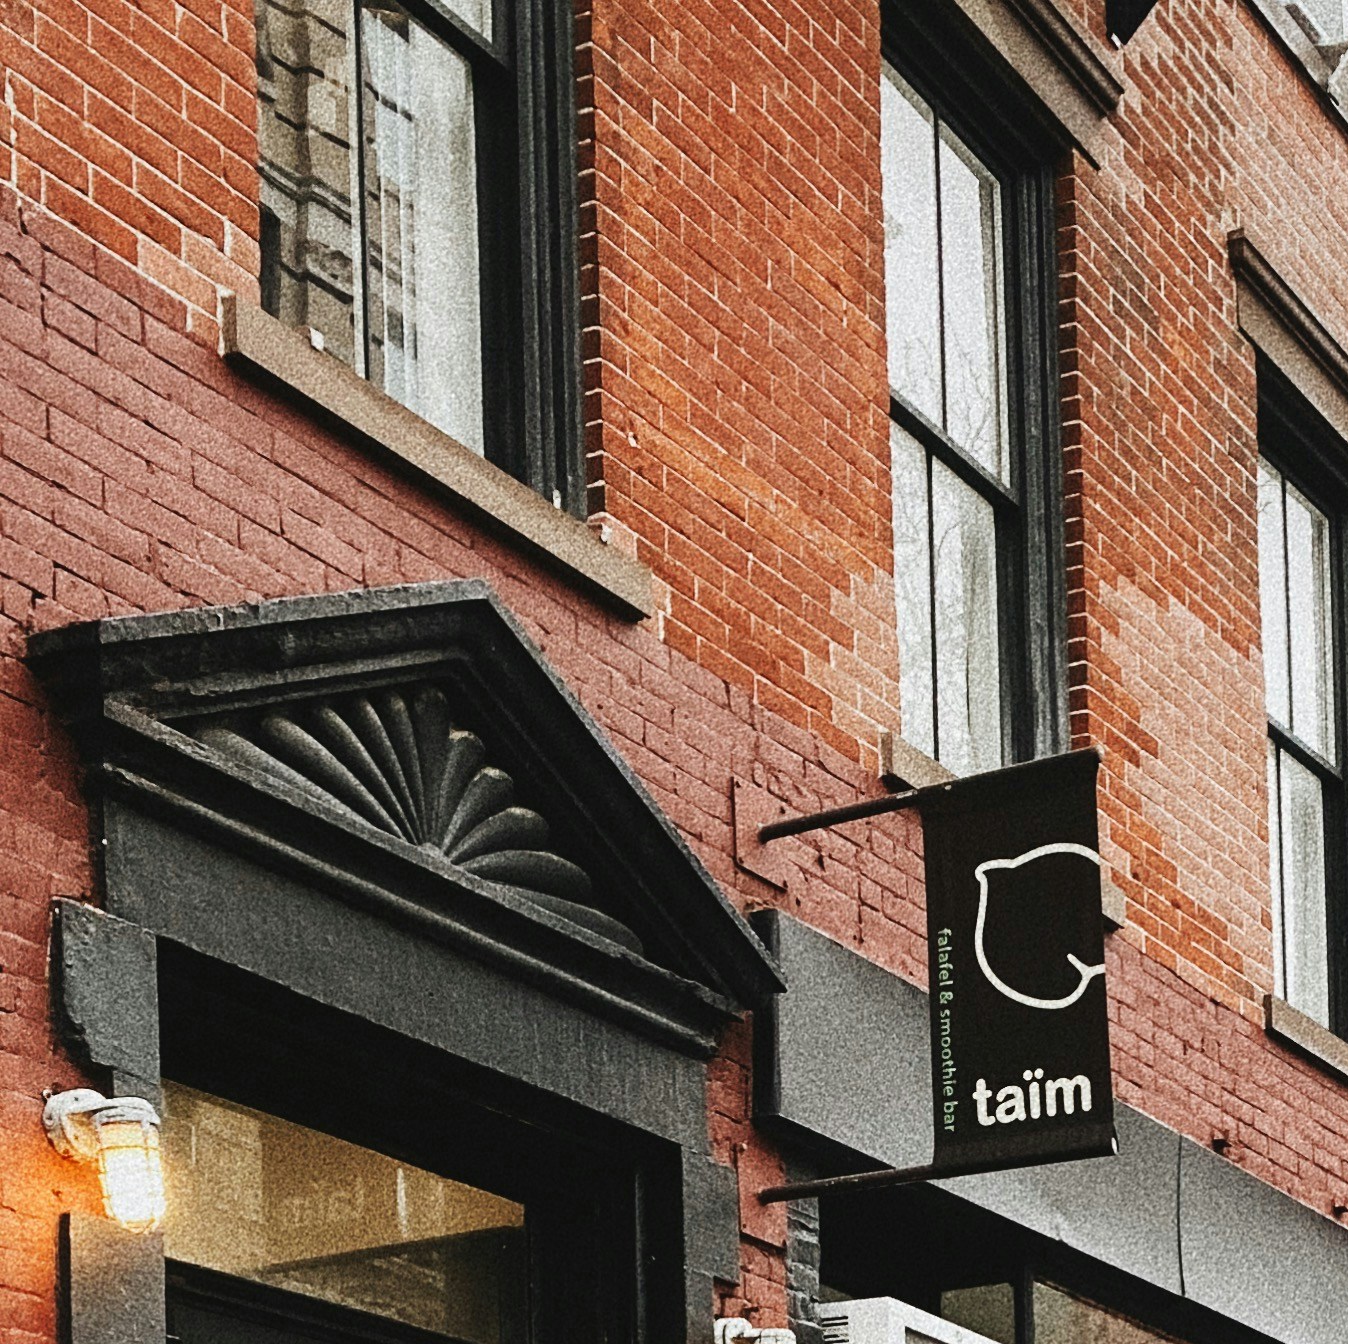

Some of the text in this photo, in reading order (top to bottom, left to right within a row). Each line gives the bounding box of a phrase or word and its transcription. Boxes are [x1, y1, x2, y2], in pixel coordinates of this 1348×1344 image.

[937, 927, 959, 1132] falafel & smoothie bar
[972, 1067, 1092, 1127] taïm
